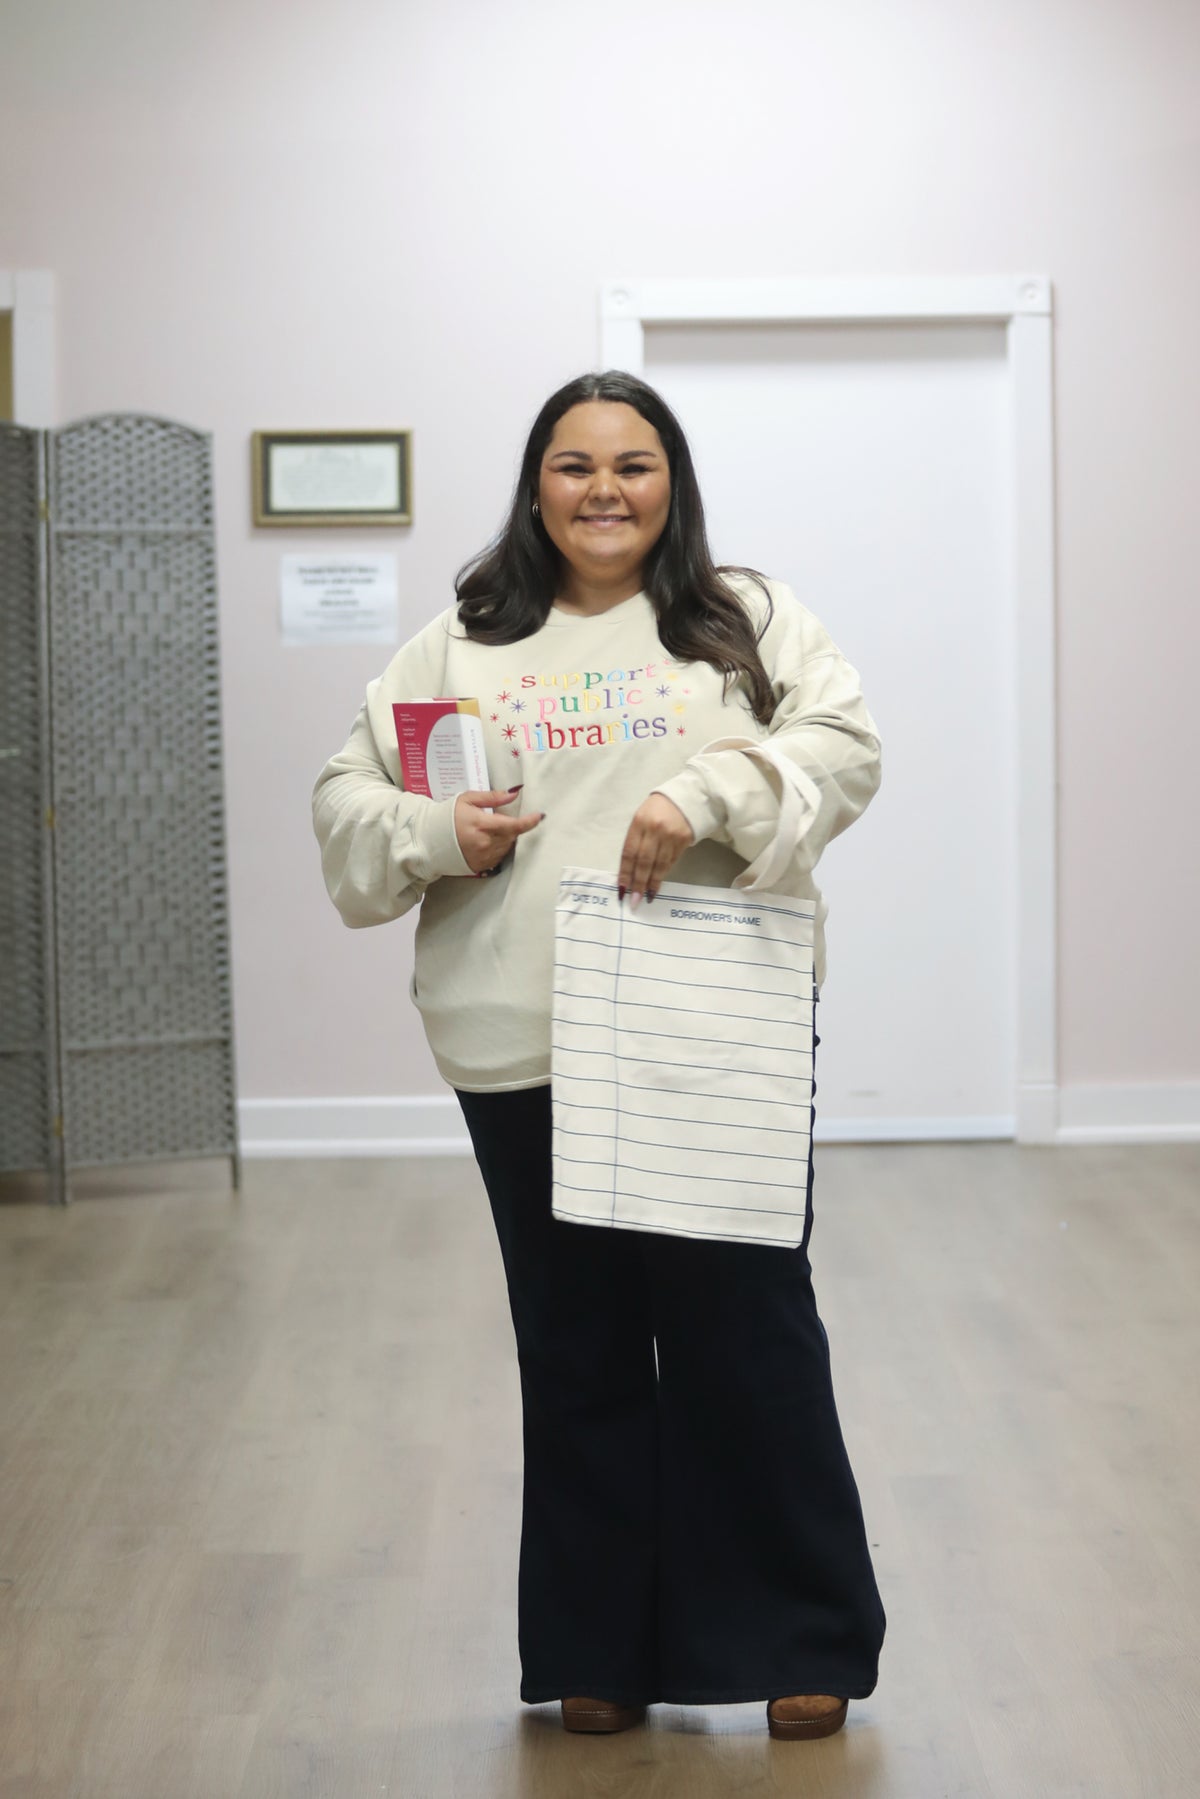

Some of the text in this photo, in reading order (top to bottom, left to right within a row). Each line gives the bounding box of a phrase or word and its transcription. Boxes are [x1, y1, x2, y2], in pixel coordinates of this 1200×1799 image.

[521, 663, 657, 690] support
[537, 687, 643, 723] public
[521, 713, 668, 752] libraries
[592, 895, 609, 906] DUE
[670, 909, 761, 926] BORROWER'S NAME
